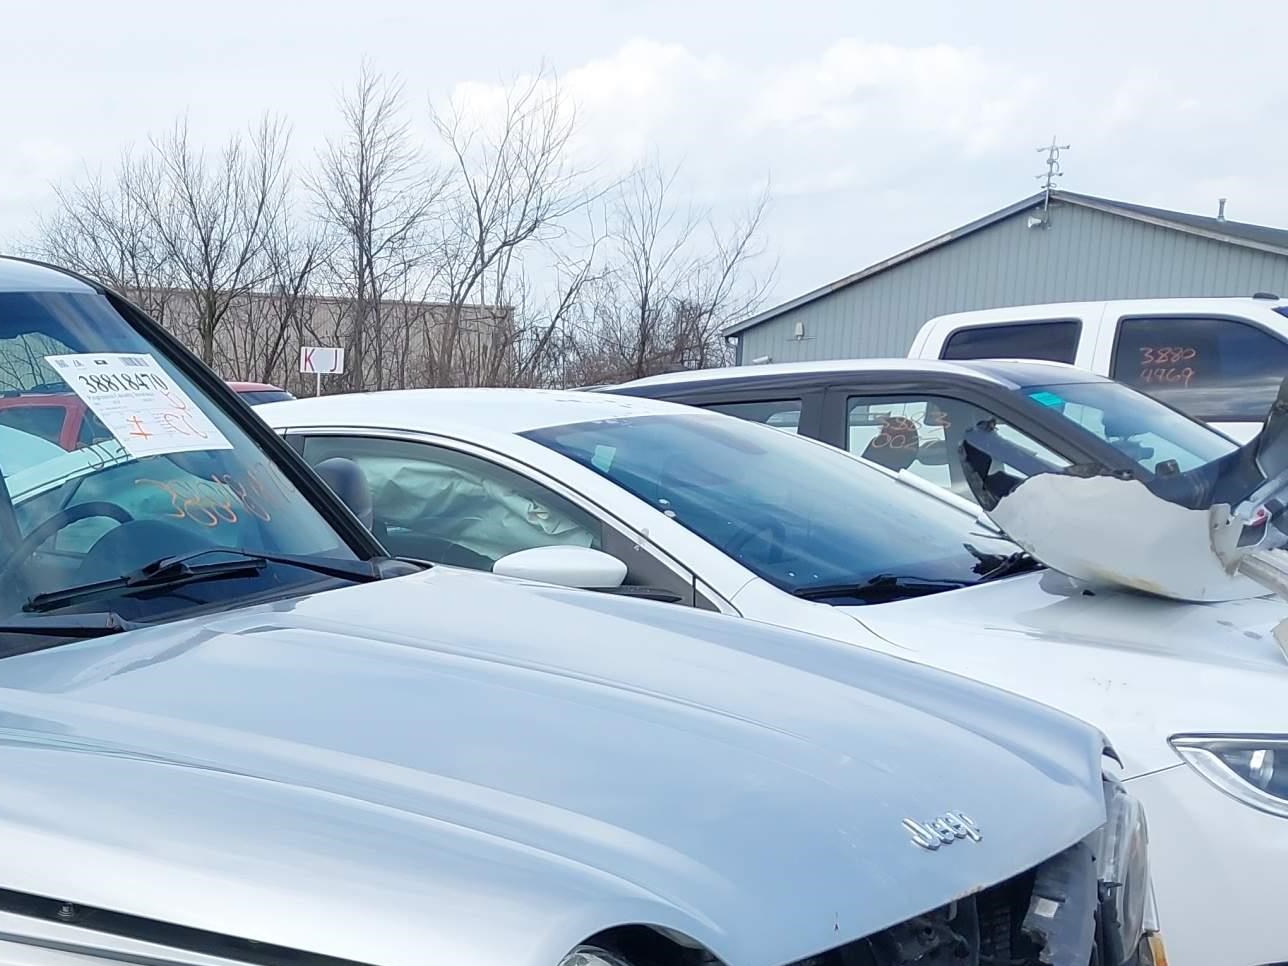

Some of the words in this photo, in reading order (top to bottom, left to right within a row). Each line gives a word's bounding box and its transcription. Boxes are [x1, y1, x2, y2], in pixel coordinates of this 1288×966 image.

[304, 348, 315, 372] K
[78, 373, 169, 395] 38818470
[901, 810, 984, 851] Jeep
